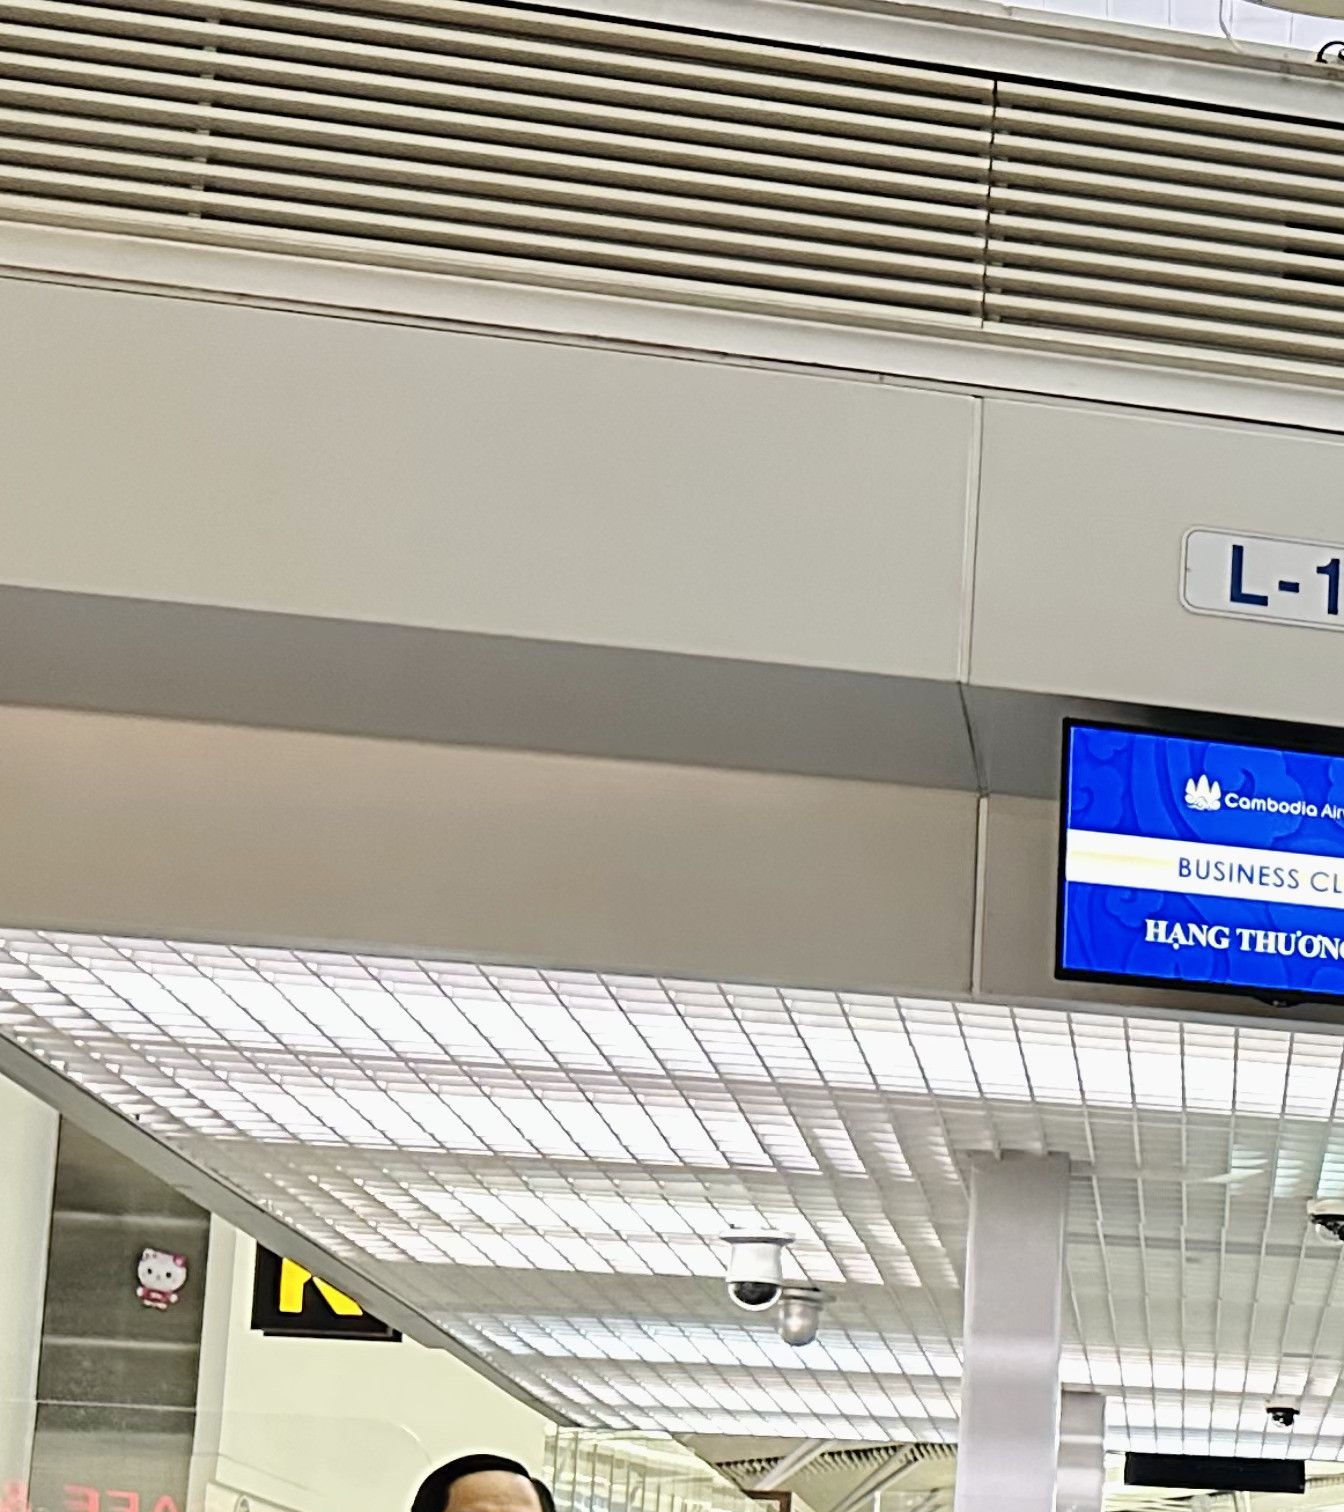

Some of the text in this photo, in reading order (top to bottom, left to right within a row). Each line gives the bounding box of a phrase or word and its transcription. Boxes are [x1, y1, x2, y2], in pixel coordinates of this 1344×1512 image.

[1229, 544, 1341, 616] L-1
[1225, 792, 1319, 818] Cambodia
[1177, 857, 1300, 890] BUSINESS
[1144, 918, 1231, 950] HẠNG
